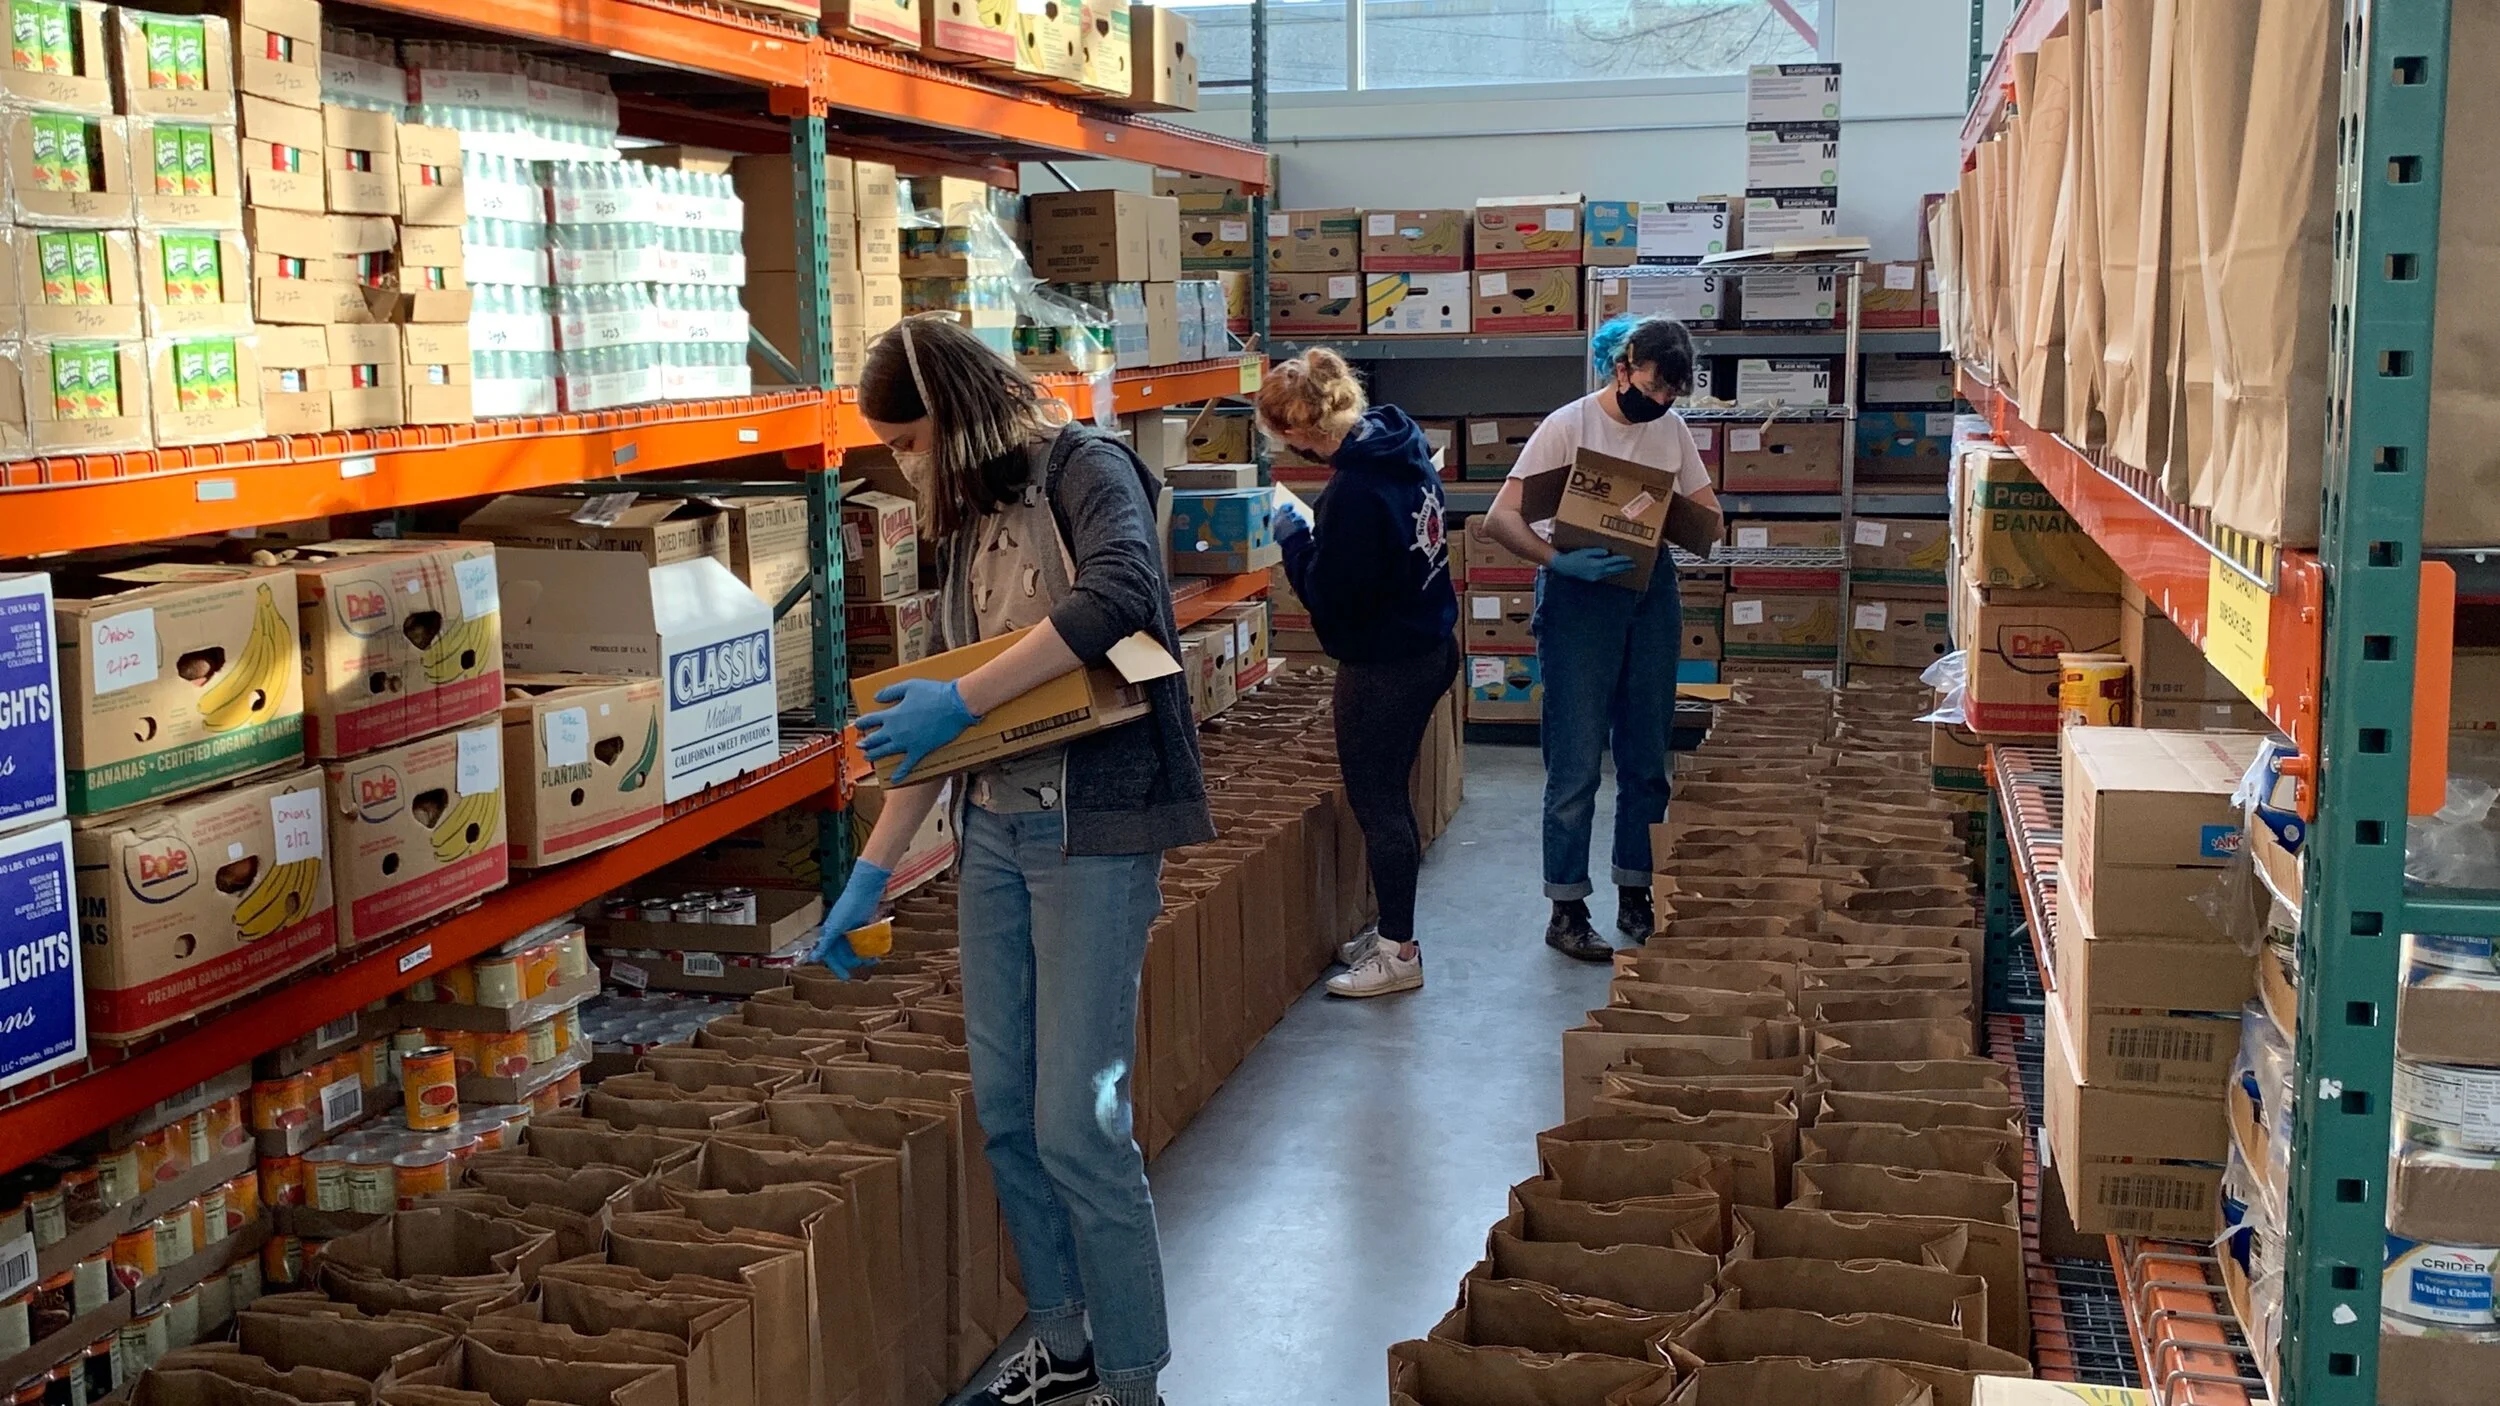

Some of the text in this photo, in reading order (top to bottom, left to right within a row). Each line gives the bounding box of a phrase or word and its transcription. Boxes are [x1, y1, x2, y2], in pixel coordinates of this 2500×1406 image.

[48, 81, 79, 100] 2/22
[275, 72, 303, 92] 2/22
[1825, 77, 1839, 93] M
[166, 95, 198, 112] 2/22
[1822, 143, 1836, 159] M
[270, 179, 296, 197] 2/22
[168, 202, 200, 217] 2/22
[1594, 205, 1619, 218] One
[1821, 210, 1835, 225] M
[1712, 214, 1723, 229] S
[1704, 277, 1714, 292] S
[1817, 276, 1832, 291] M
[75, 309, 104, 330] 2/22
[1697, 373, 1708, 388] S
[1813, 374, 1827, 388] M
[185, 414, 214, 430] 2/22
[1571, 471, 1612, 493] Dole
[766, 508, 780, 526] FRUIT
[657, 533, 677, 553] DRIED
[678, 528, 697, 549] FRUIT
[346, 591, 385, 618] Dole
[781, 616, 797, 633] FRUIT
[590, 645, 618, 653] PRODUCT
[2012, 634, 2064, 655] Dole
[106, 653, 141, 677] 2/22
[674, 633, 768, 705] CLASSIC
[1758, 666, 1791, 674] BANANAS
[705, 701, 742, 732] Medium
[1984, 709, 2027, 719] PREMIUM
[675, 724, 771, 768] CALIFORNIA SWEET POTATOES
[87, 760, 146, 791] BANANAS
[157, 742, 211, 773] CERTIFIED
[212, 728, 256, 757] ORGANIC
[542, 763, 593, 788] PLANTAINS
[361, 774, 397, 803] Dole
[138, 847, 188, 881] Dole
[147, 975, 197, 1006] PREMIUM
[198, 957, 243, 987] BANANAS
[2421, 1258, 2485, 1272] CRIDER
[2416, 1282, 2489, 1298] White Chicken
